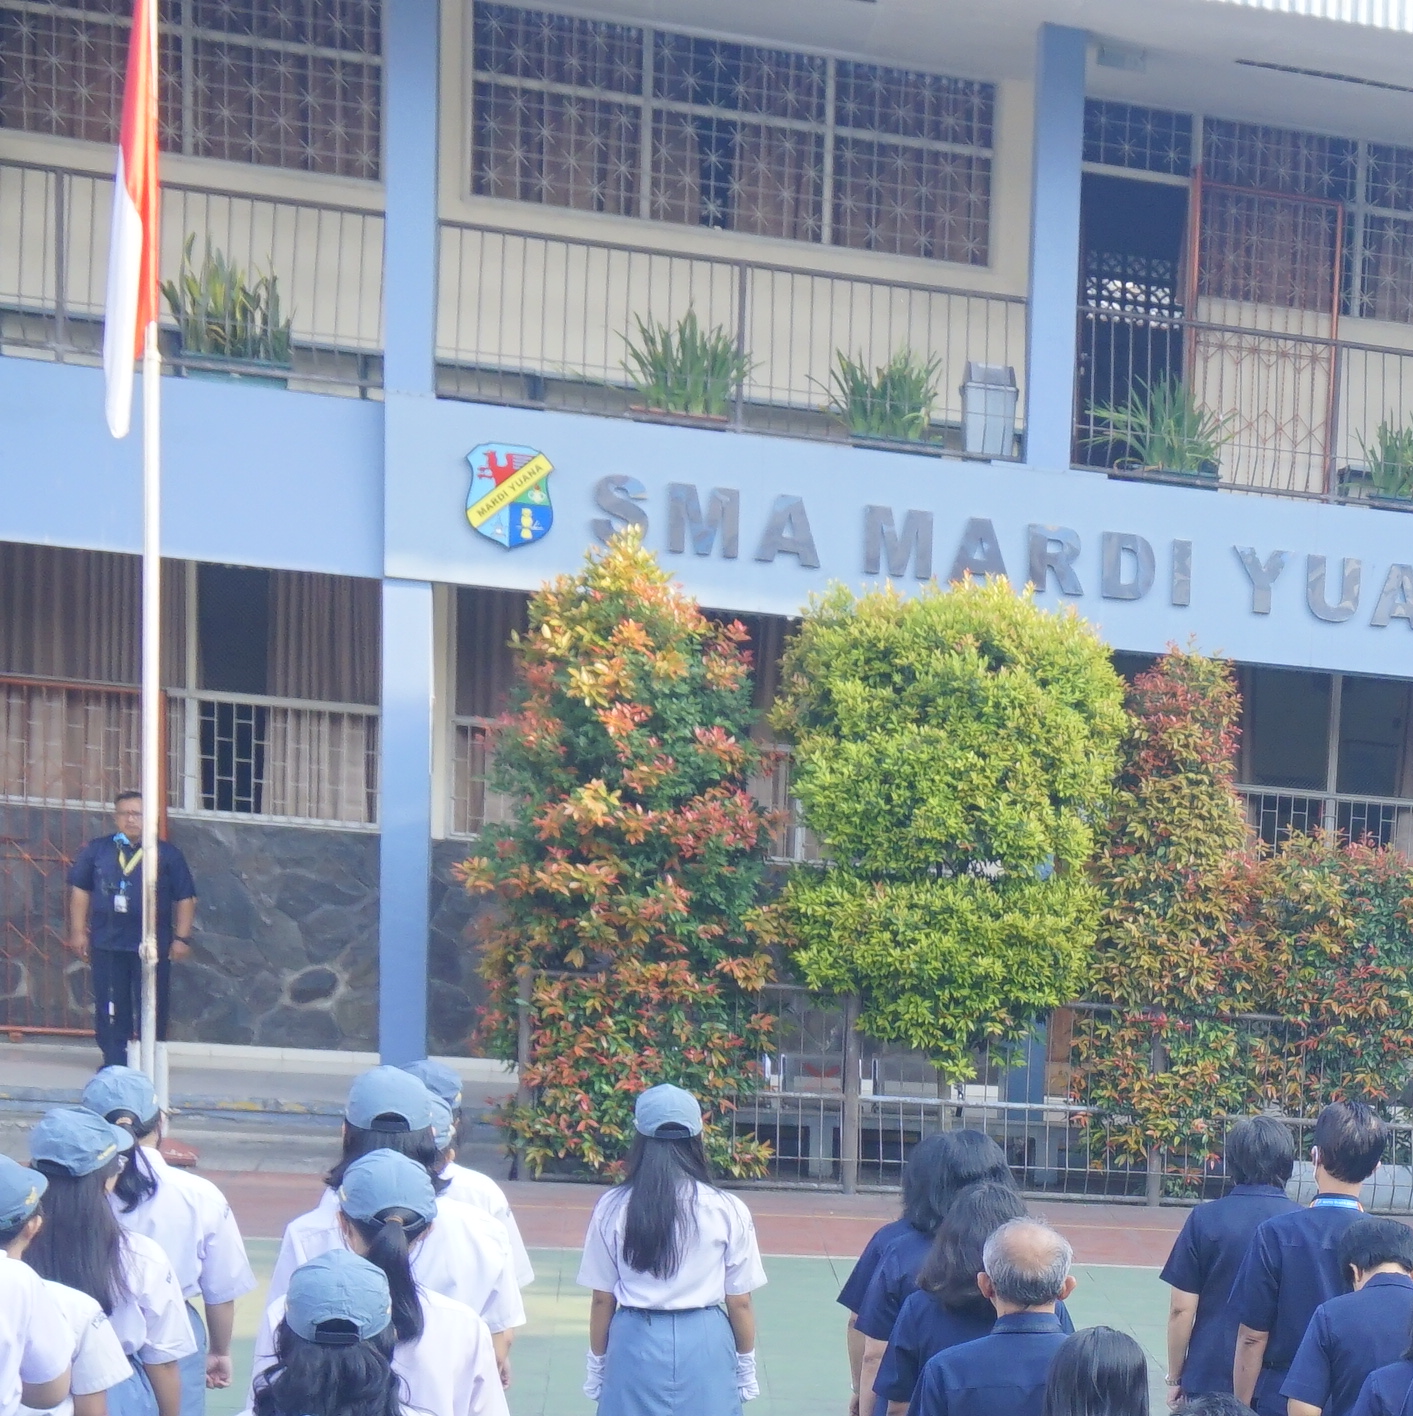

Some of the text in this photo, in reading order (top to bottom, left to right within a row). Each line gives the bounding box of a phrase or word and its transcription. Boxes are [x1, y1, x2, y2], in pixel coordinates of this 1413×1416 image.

[476, 463, 544, 518] MARDI YUANA
[591, 473, 821, 569] SMA
[863, 503, 1193, 607] MARDI
